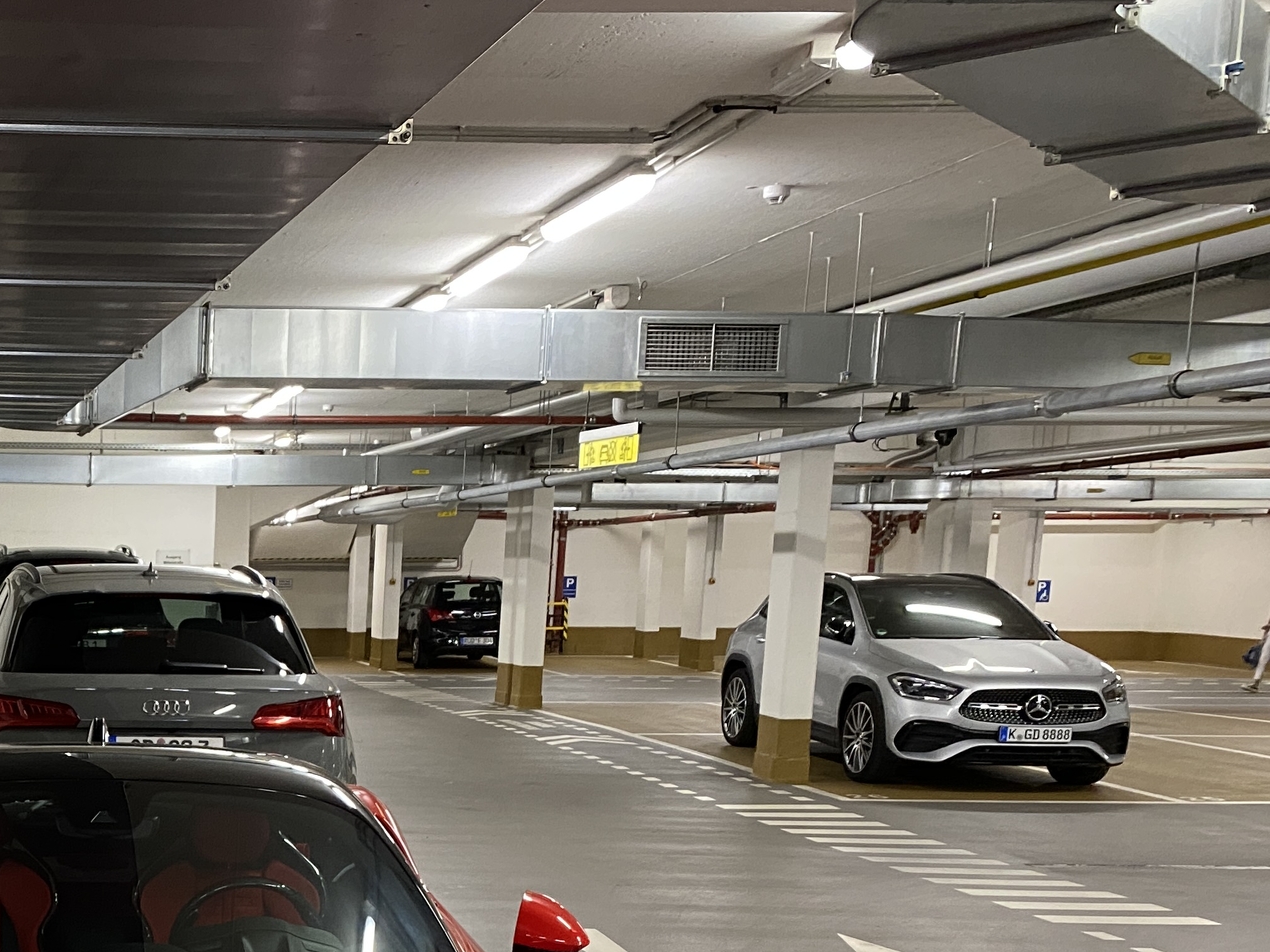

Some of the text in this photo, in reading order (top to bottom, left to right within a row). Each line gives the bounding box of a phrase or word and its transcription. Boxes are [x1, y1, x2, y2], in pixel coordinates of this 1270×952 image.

[566, 578, 575, 588] P
[1038, 581, 1047, 592] P
[1008, 728, 1070, 740] K GD 8888
